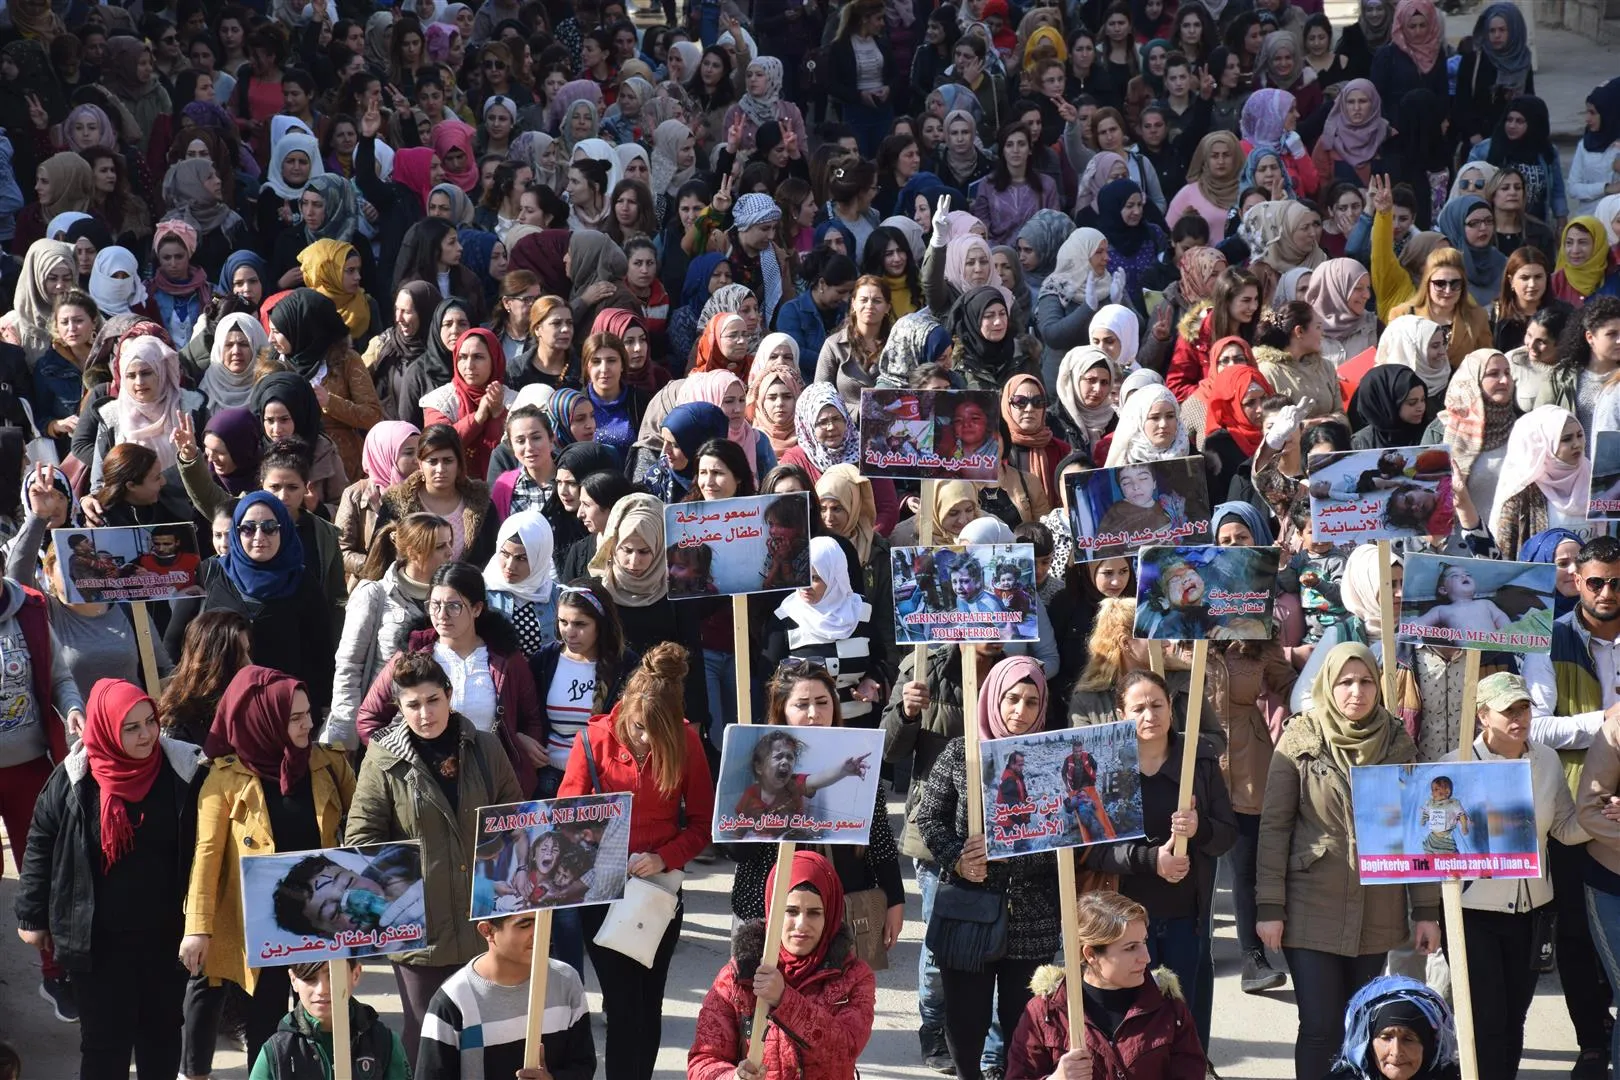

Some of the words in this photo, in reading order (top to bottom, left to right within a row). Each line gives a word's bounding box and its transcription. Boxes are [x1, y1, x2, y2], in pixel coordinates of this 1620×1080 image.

[865, 450, 917, 468] الطفولة
[917, 454, 941, 467] ضد
[941, 455, 981, 471] للحرب
[983, 455, 996, 469] لا
[722, 505, 760, 522] اسمعو
[1317, 501, 1357, 517] ضمير
[1360, 500, 1381, 515] اين
[676, 511, 720, 524] صرخة
[726, 526, 762, 543] اطفال
[1155, 522, 1194, 541] للحرب
[1195, 520, 1209, 534] لا
[1320, 519, 1382, 536] الانسانية
[678, 530, 722, 548] عفرين
[1078, 531, 1129, 550] الطفولة
[1130, 529, 1153, 544] ضد
[116, 575, 162, 587] GREATER
[162, 571, 189, 585] THAN
[103, 590, 129, 599] YOUR
[131, 587, 169, 598] TERROR
[1208, 588, 1243, 601] صرخات
[1243, 589, 1269, 600] اسمعو
[938, 612, 948, 623] IS
[949, 611, 992, 623] GREATER
[995, 611, 1023, 622] THAN
[1208, 603, 1238, 615] عفرين
[1238, 602, 1265, 615] اطفال
[932, 627, 960, 639] YOUR
[961, 627, 1001, 638] TERROR
[1401, 623, 1463, 641] PÊŞEROJA
[1466, 630, 1488, 642] ME
[1489, 632, 1507, 644] NE
[1510, 634, 1551, 648] KUJIN
[567, 679, 594, 702] Lee
[991, 796, 1036, 822] ضمير
[1039, 794, 1064, 816] اين
[484, 811, 548, 833] ZAROKA
[551, 807, 574, 824] NE
[577, 802, 623, 823] KUJIN
[718, 813, 755, 832] عفرين
[755, 814, 787, 831] اطفال
[790, 814, 833, 832] صرخات
[833, 818, 866, 832] اسمعو
[993, 819, 1064, 846] الانسانية
[1412, 859, 1430, 871] Tirk
[1434, 858, 1467, 872] Kuştina
[1468, 858, 1492, 870] zarok
[1500, 857, 1523, 871] jinan
[330, 929, 377, 951] اطفال
[377, 924, 422, 947] انقذو
[261, 935, 326, 959] عفرين
